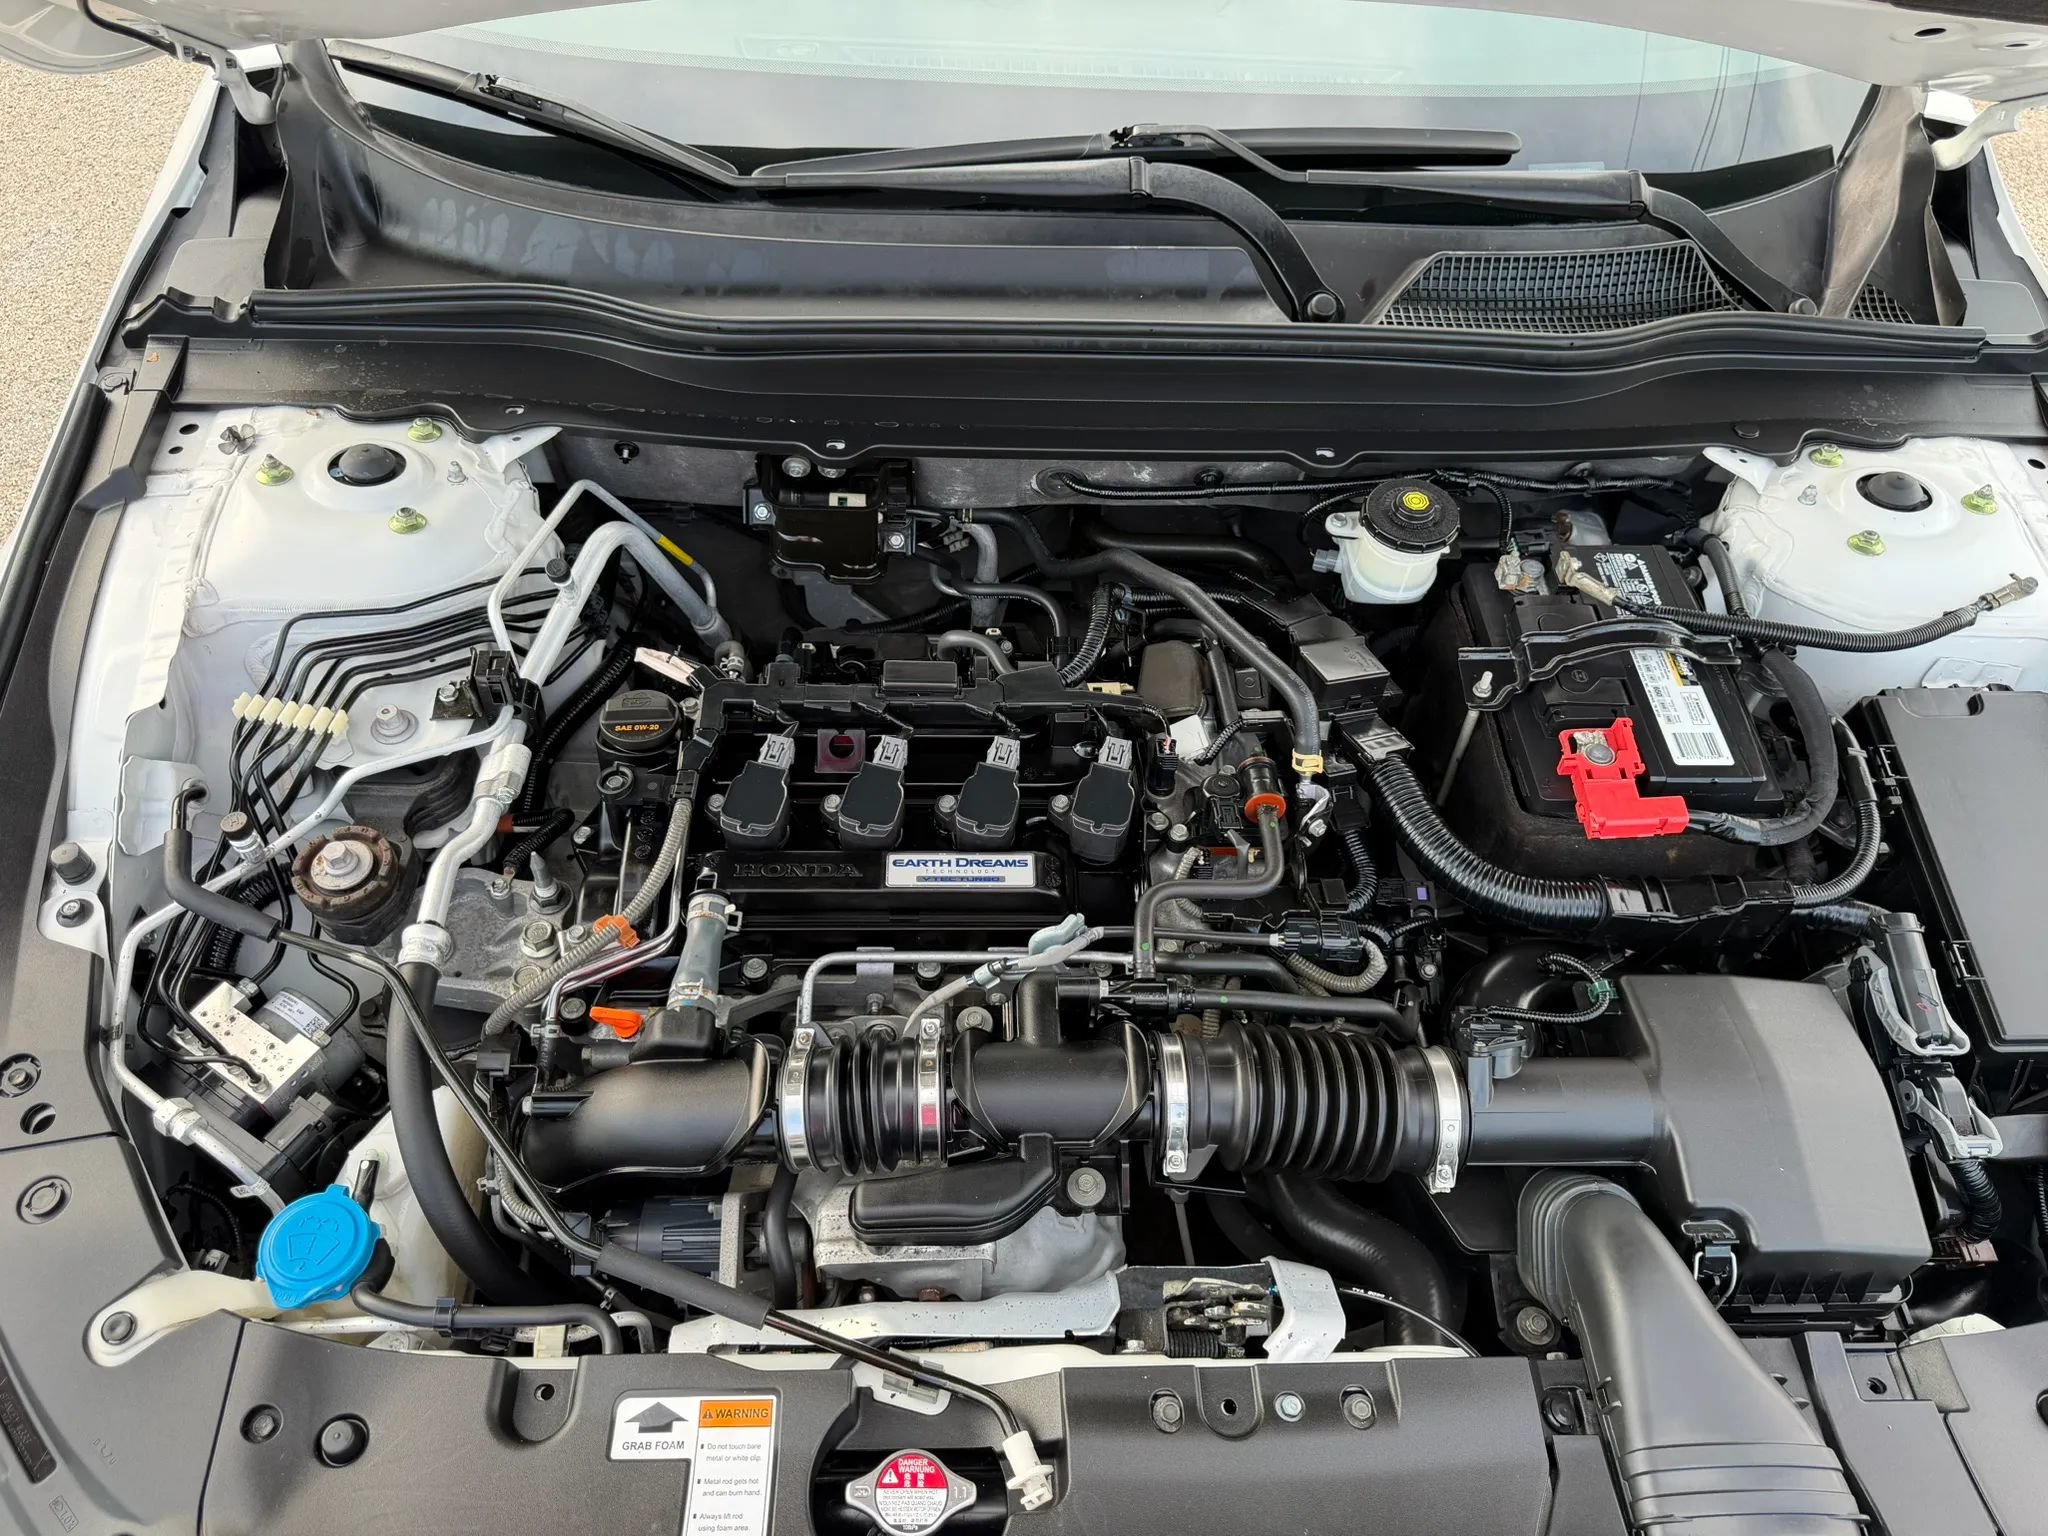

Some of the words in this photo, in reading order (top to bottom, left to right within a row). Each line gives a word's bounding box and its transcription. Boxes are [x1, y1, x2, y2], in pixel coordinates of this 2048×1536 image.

[892, 858, 952, 868] EARTH
[955, 857, 1029, 868] DREAMS
[733, 863, 864, 878] HONDA
[715, 1408, 769, 1419] WARNING
[622, 1441, 652, 1451] GRAB
[655, 1440, 685, 1450] FOAM
[898, 1458, 928, 1466] DANGER
[954, 1486, 967, 1498] 1.1
